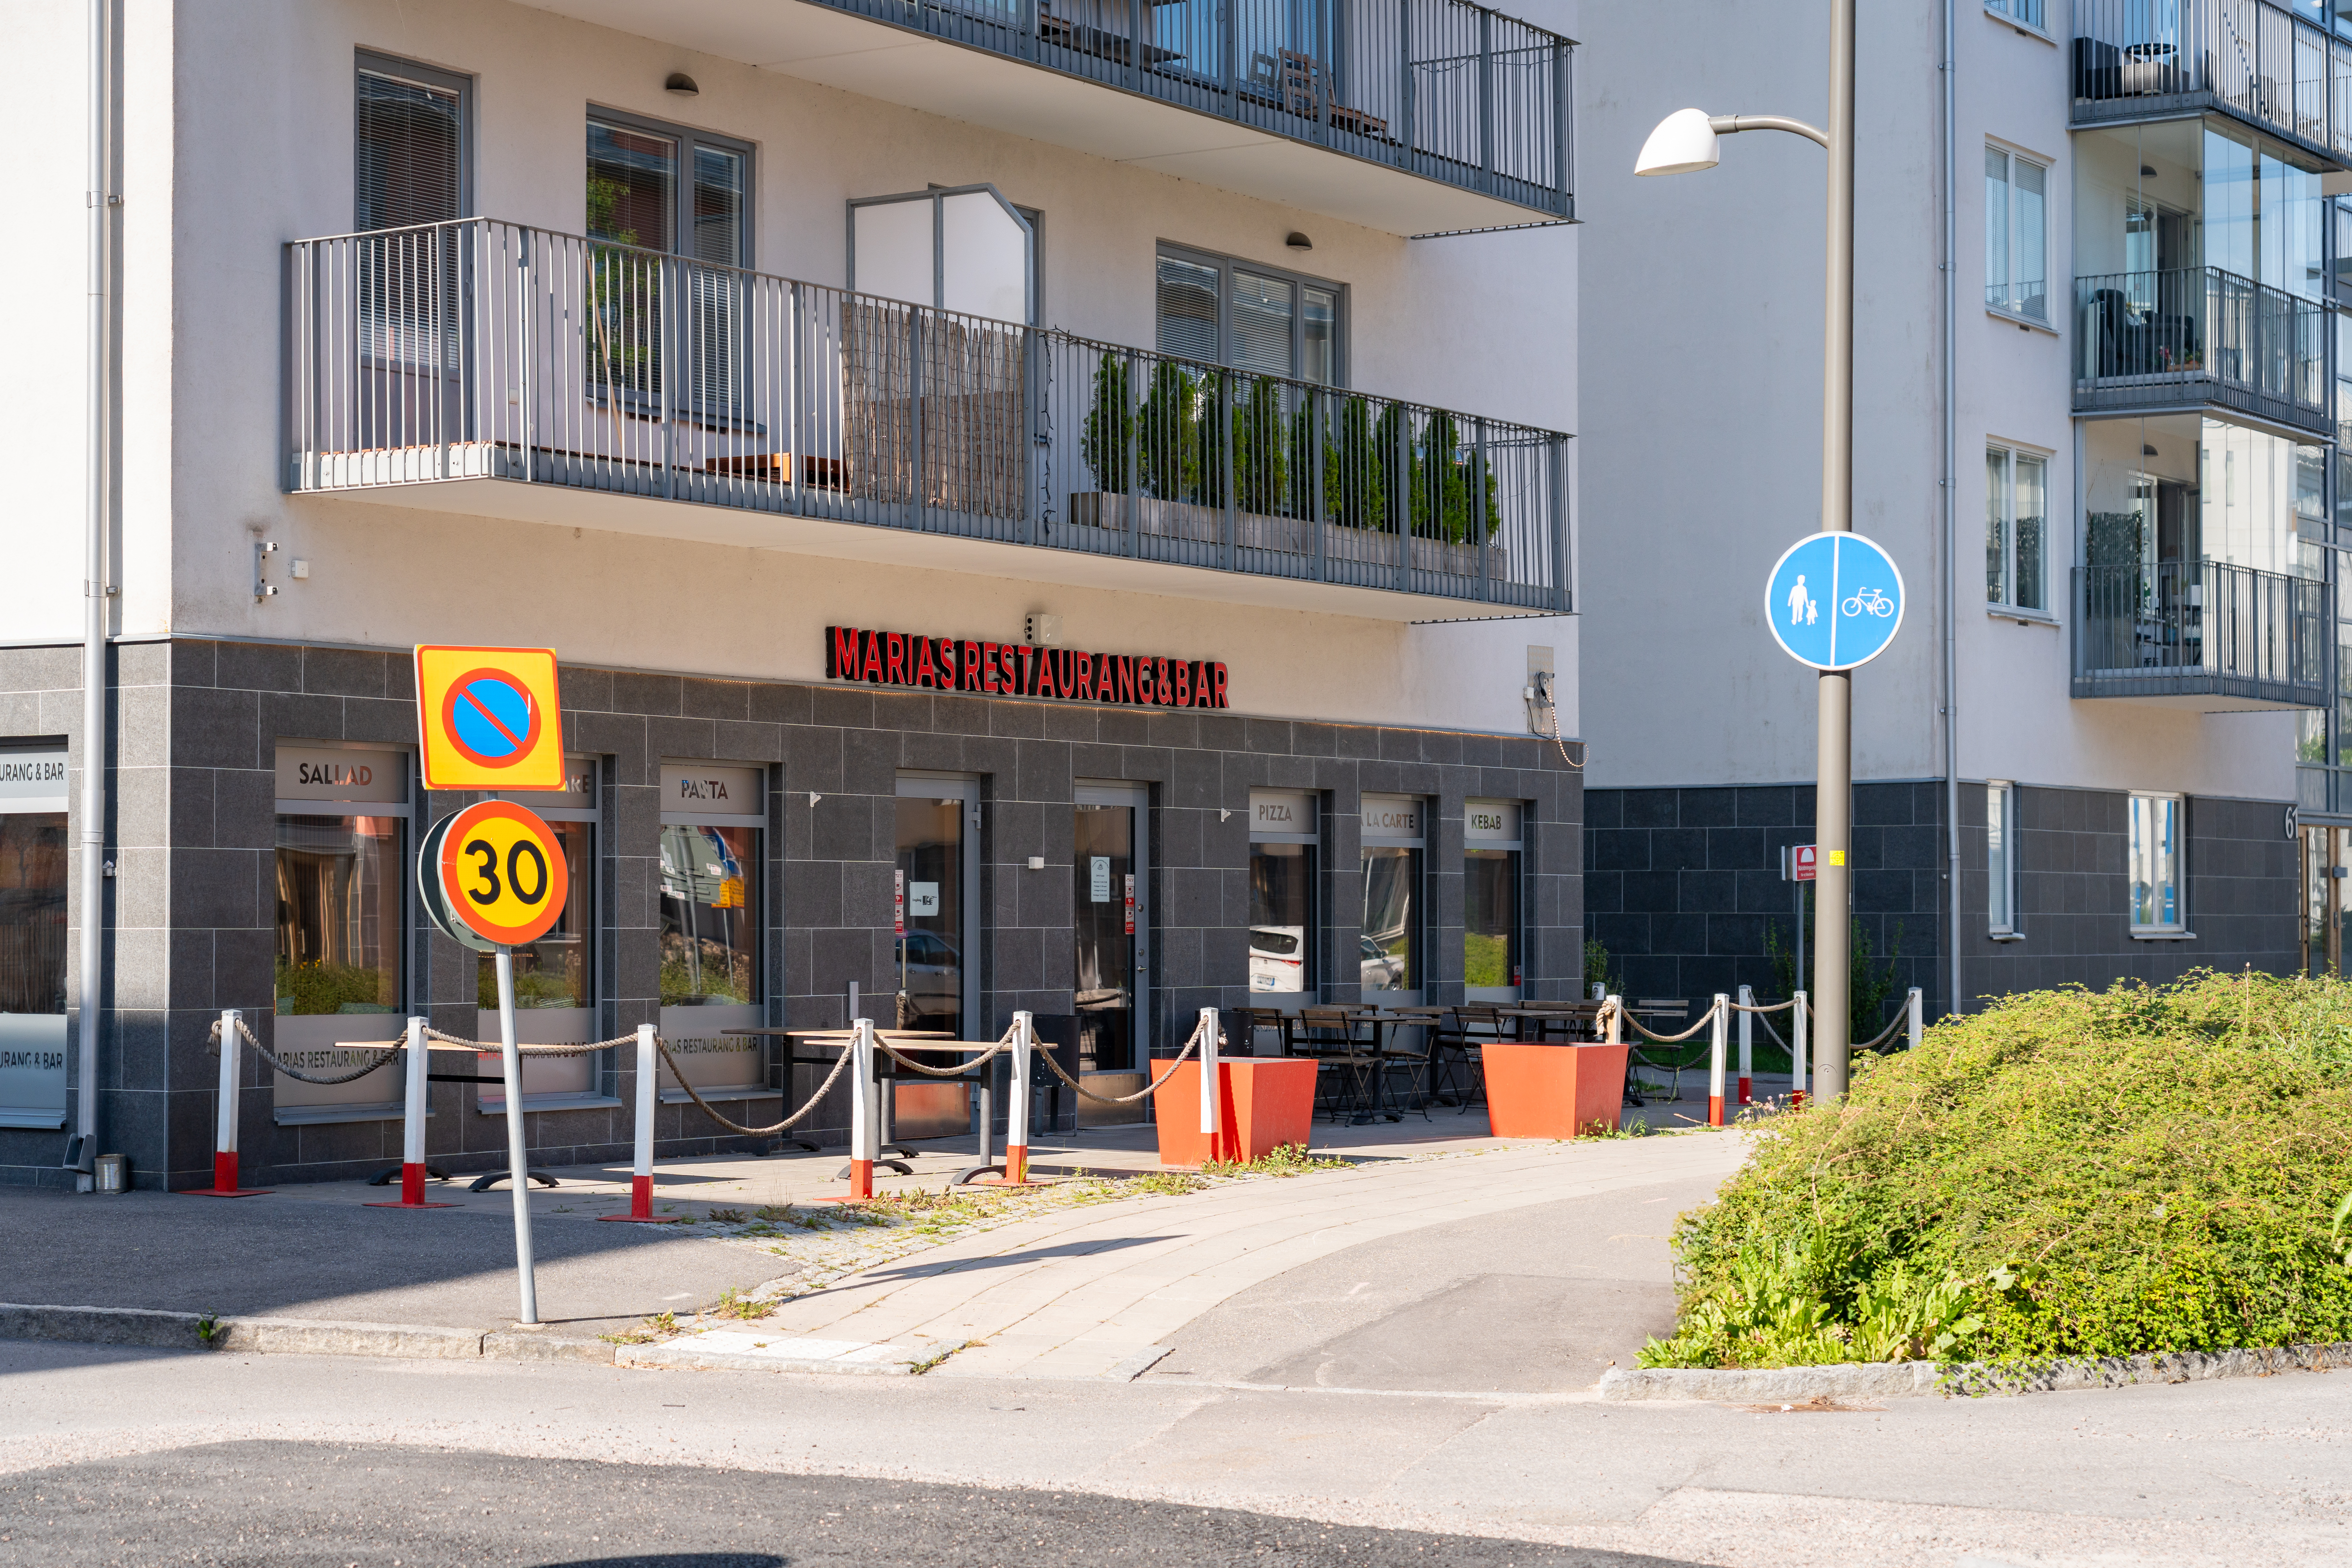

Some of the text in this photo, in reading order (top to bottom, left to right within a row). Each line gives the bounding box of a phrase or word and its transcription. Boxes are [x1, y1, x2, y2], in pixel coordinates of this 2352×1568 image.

[834, 626, 956, 689] MARIAS
[35, 763, 41, 781] &
[45, 763, 64, 780] BAR
[299, 763, 372, 786] SALLAD
[681, 779, 729, 800] PASTA
[1259, 805, 1292, 821] PIZZA
[1367, 812, 1380, 827] LA
[1382, 813, 1414, 828] CARTE
[1471, 814, 1502, 830] KEBAB
[2285, 806, 2298, 839] 61
[465, 839, 547, 906] 30
[684, 1037, 734, 1054] RESTAURANG
[736, 1037, 741, 1052] &
[743, 1036, 757, 1052] BAR
[34, 1051, 40, 1069] &
[43, 1052, 63, 1070] BAR
[274, 1051, 304, 1069] ARIAS
[308, 1049, 370, 1069] RESTAURANG
